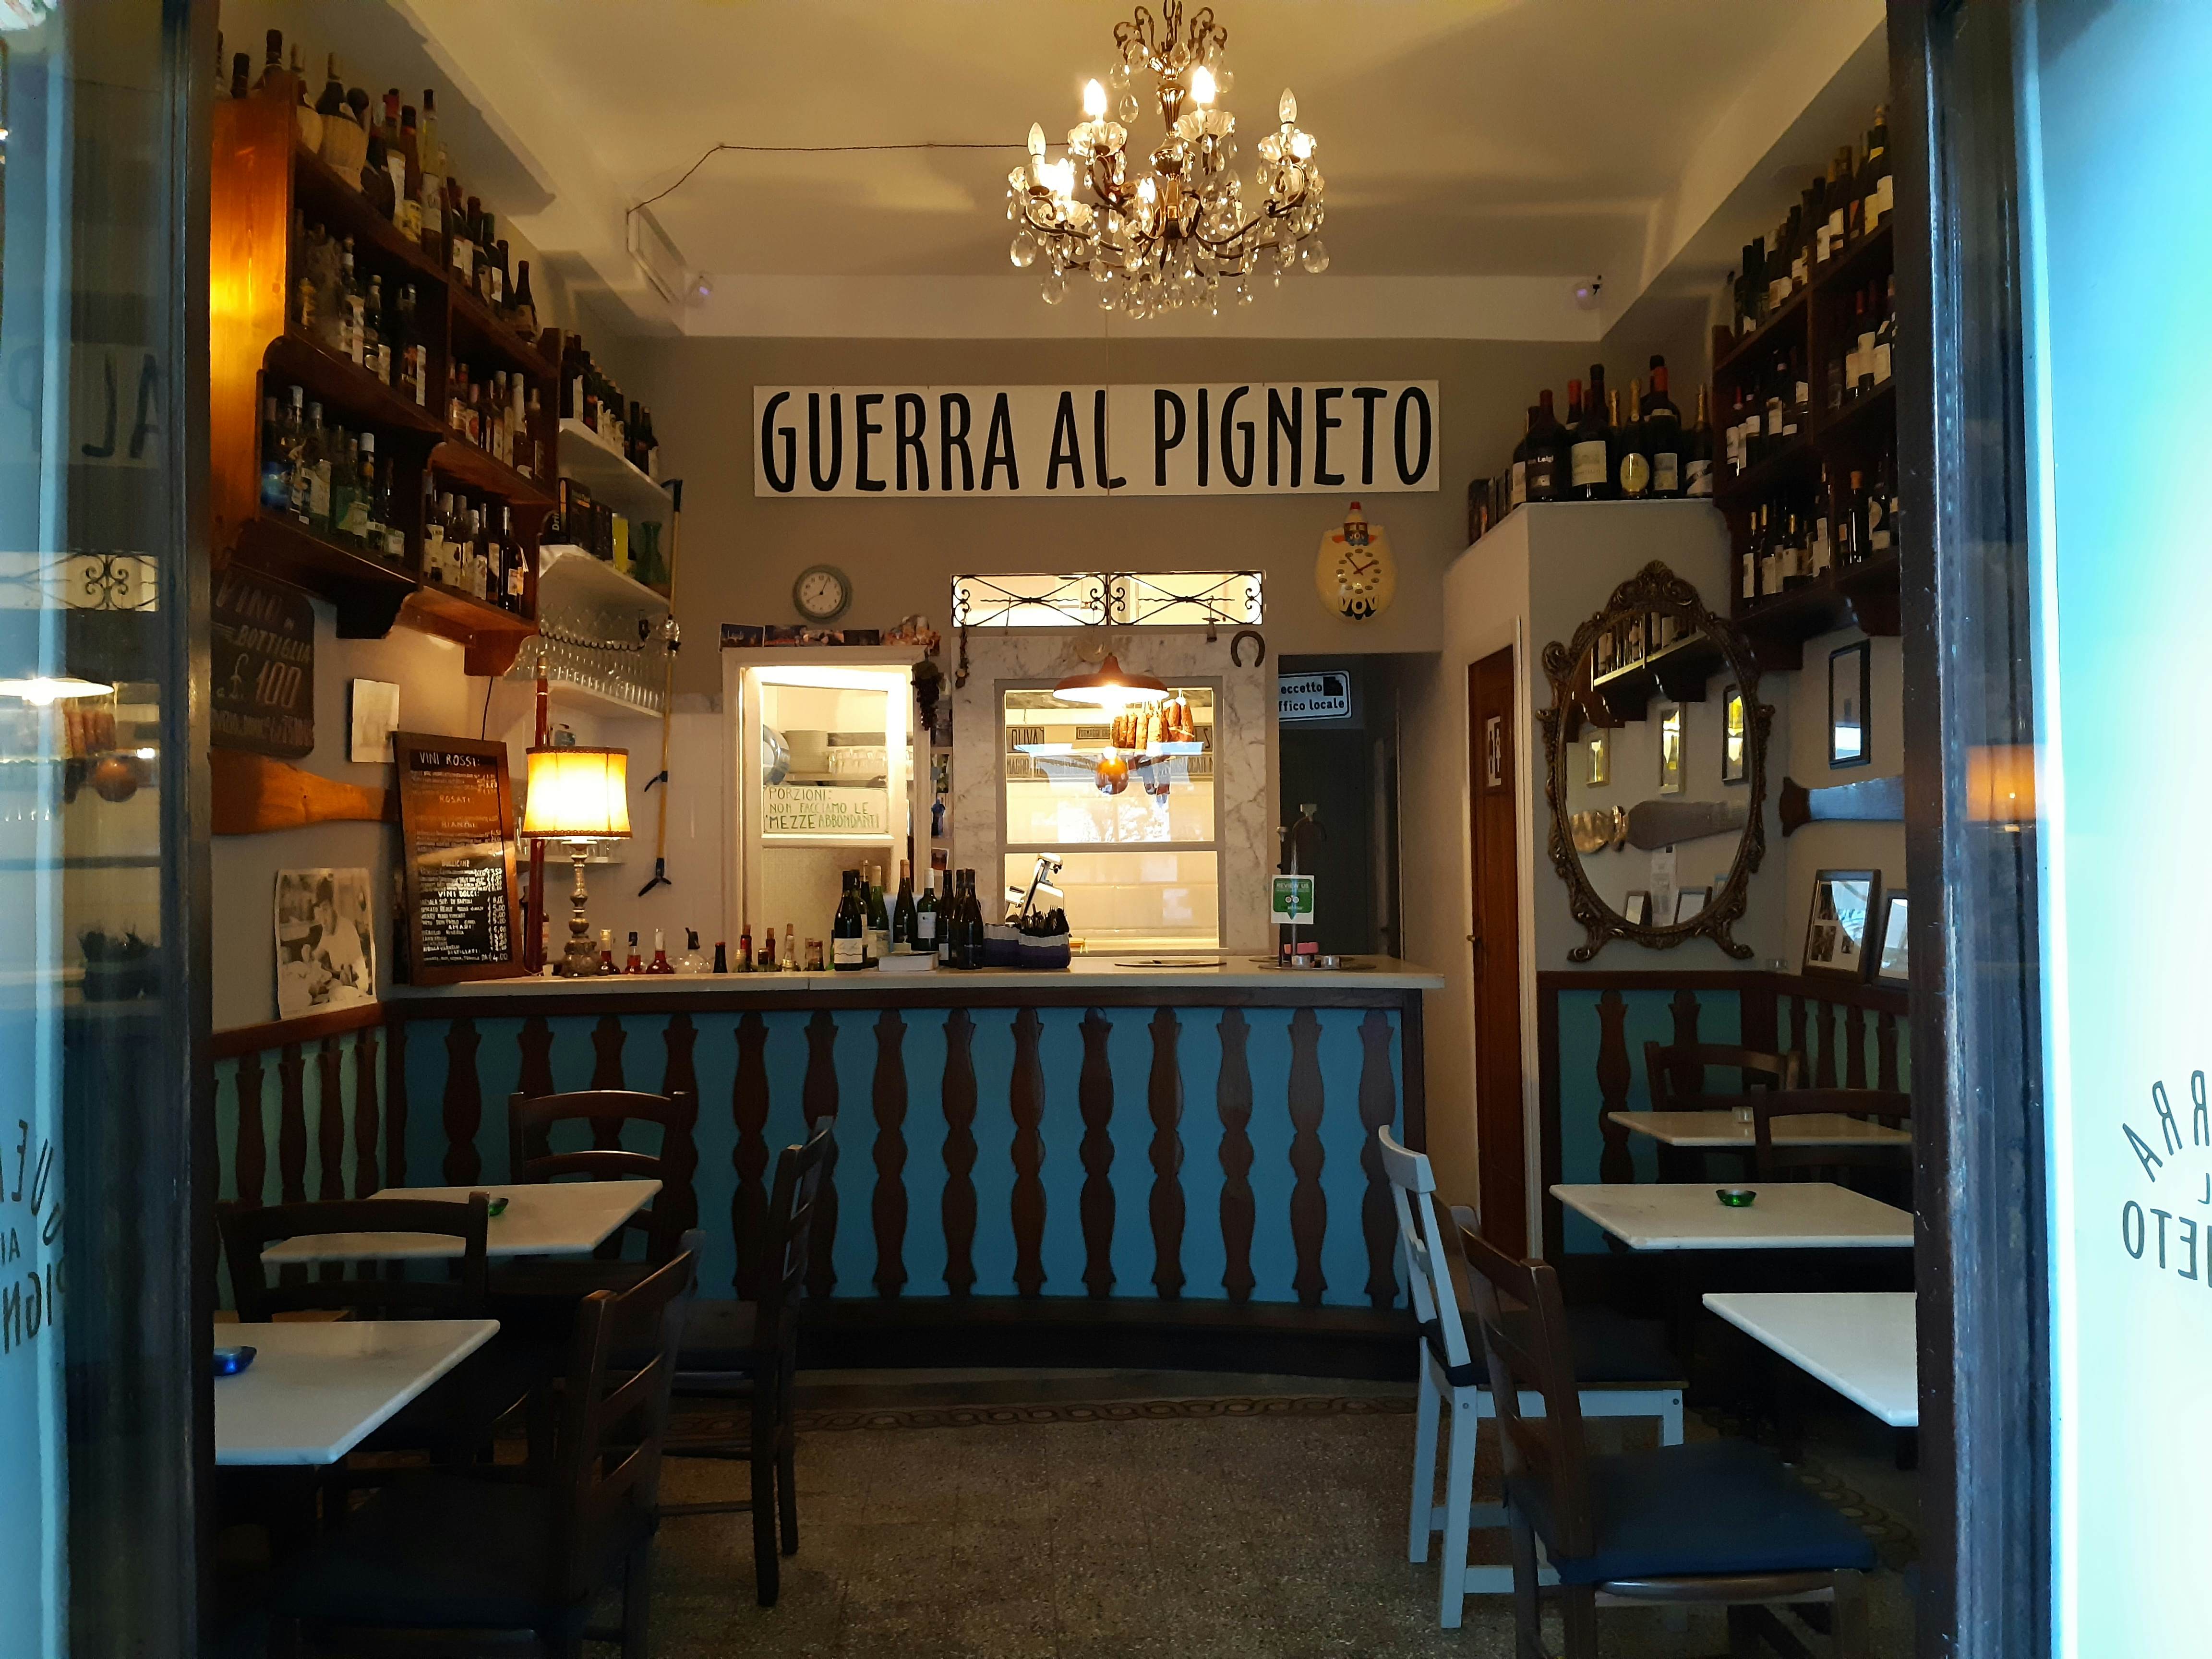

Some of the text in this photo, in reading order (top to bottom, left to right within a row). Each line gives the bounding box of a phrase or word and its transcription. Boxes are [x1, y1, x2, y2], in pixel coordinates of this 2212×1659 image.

[762, 385, 1432, 493] GUERRA AL PIGNETO
[1281, 681, 1322, 694] eccetto
[1309, 697, 1345, 710] locale
[420, 751, 480, 767] VINI ROSSI:
[769, 788, 831, 801] PORZIONI:
[769, 802, 868, 814] NON FACCIAMO LE
[818, 814, 879, 829] ABBONDANTI
